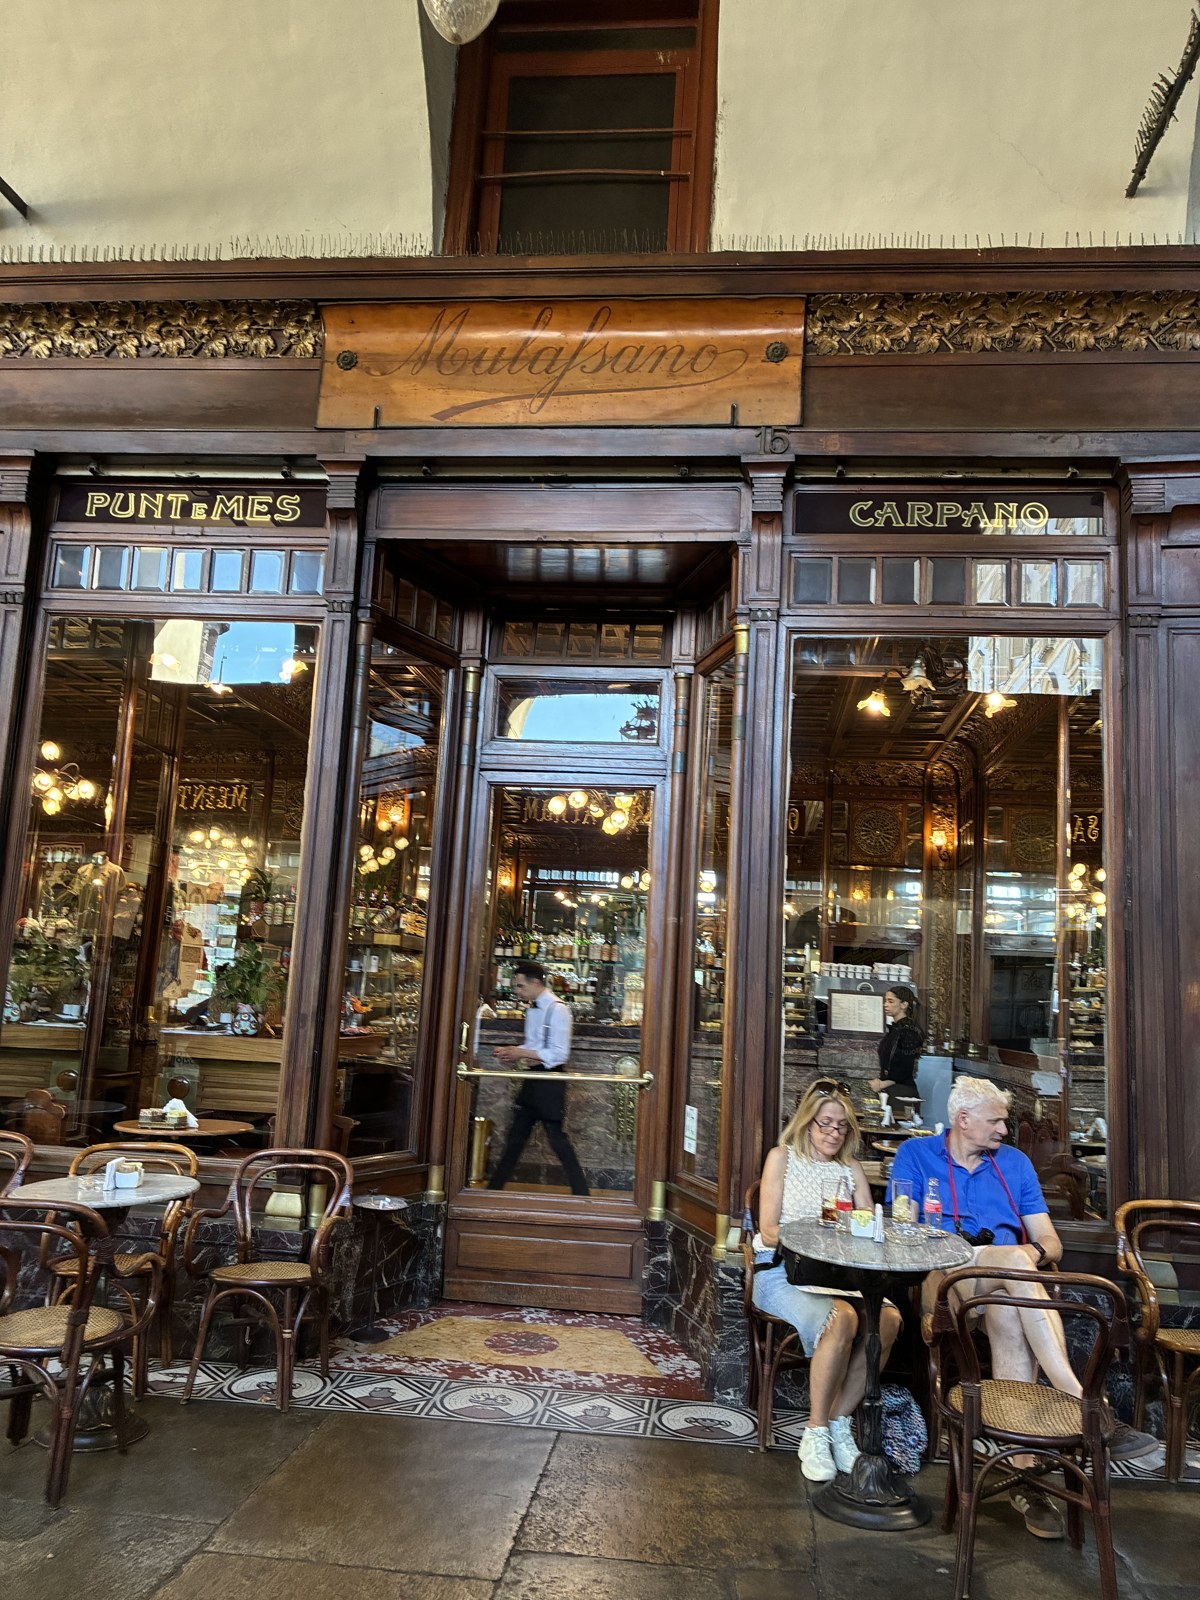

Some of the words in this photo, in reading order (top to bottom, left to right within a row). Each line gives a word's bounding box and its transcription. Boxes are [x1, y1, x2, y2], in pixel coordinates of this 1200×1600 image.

[755, 426, 790, 455] 15
[85, 492, 189, 519] PUNT
[210, 494, 301, 521] MES
[849, 500, 1049, 528] CARPANO
